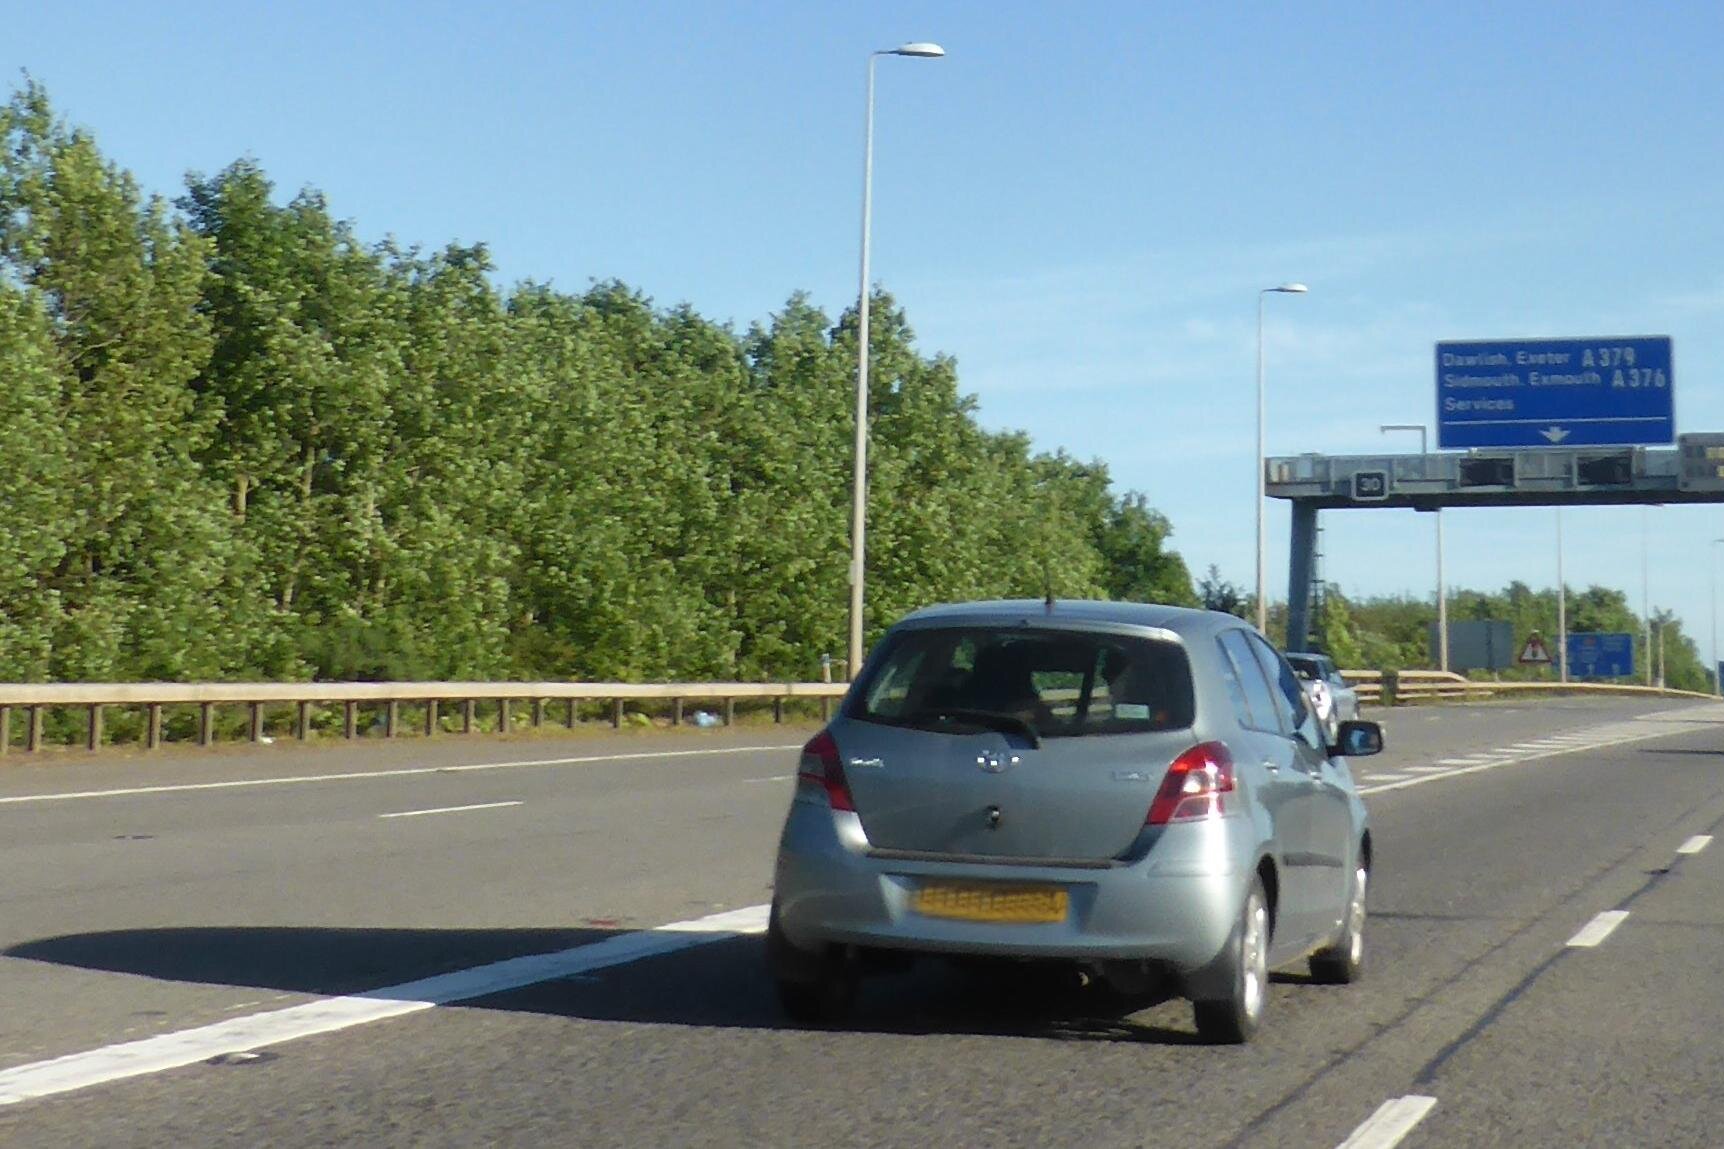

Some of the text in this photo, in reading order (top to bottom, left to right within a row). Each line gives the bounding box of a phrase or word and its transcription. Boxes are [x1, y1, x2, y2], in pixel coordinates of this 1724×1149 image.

[1517, 350, 1571, 365] Exeter
[1529, 371, 1601, 386] Exmouth
[1446, 397, 1514, 412] Services
